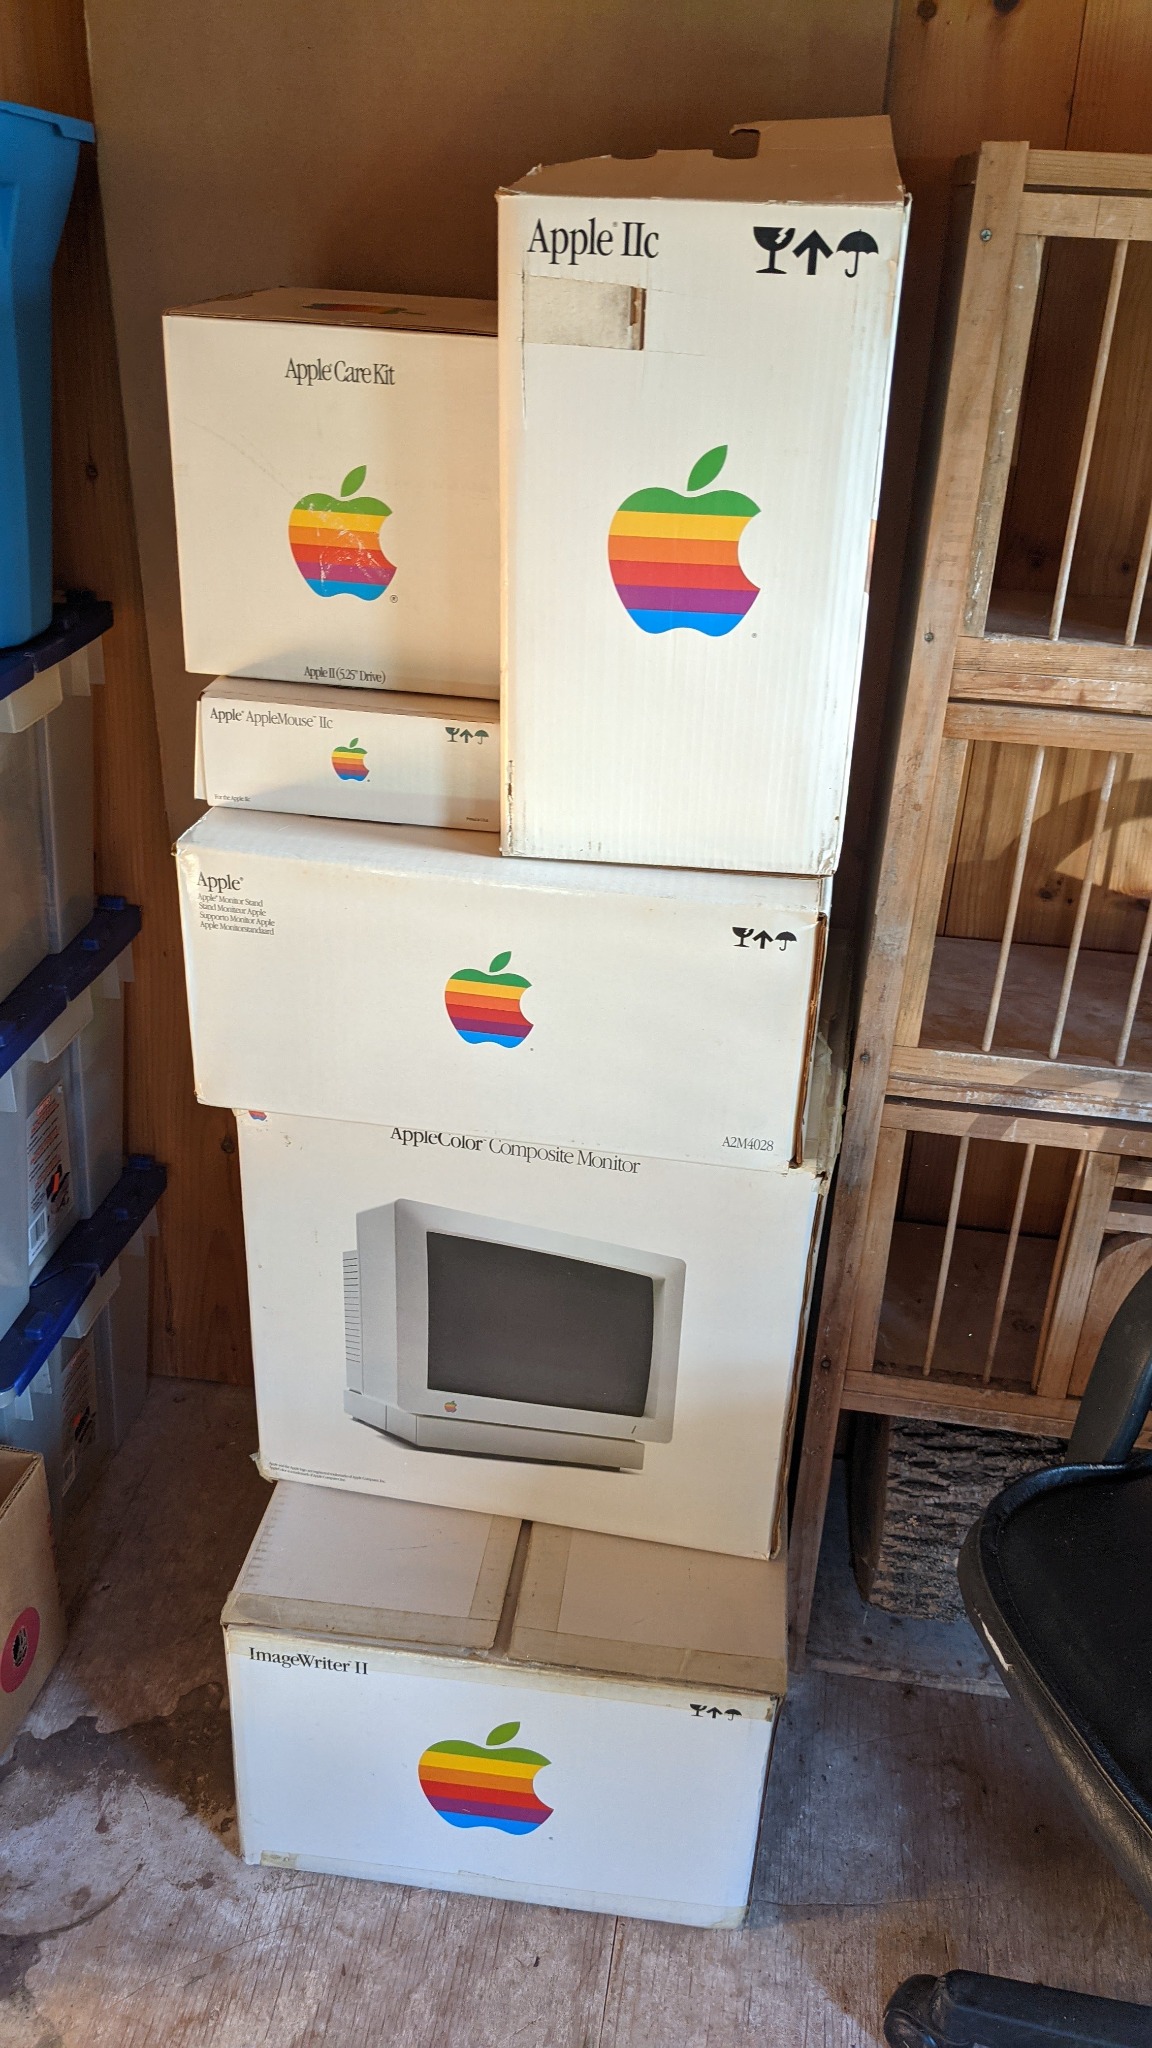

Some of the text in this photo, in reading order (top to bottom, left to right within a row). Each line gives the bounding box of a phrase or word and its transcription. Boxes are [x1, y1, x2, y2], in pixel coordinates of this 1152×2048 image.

[620, 221, 660, 259] IIc
[334, 360, 372, 384] Care
[373, 363, 396, 385] Kit
[304, 666, 328, 680] Apple
[219, 896, 244, 905] Monitor
[245, 898, 264, 907] Stand
[199, 902, 216, 910] Stand
[247, 908, 266, 917] Apple
[200, 911, 275, 927] Supporto Monitor Apple
[200, 920, 219, 930] Apple
[722, 1136, 774, 1151] A2M4028
[489, 1138, 574, 1164] Composite
[577, 1149, 641, 1174] Monitor
[355, 1661, 369, 1675] II
